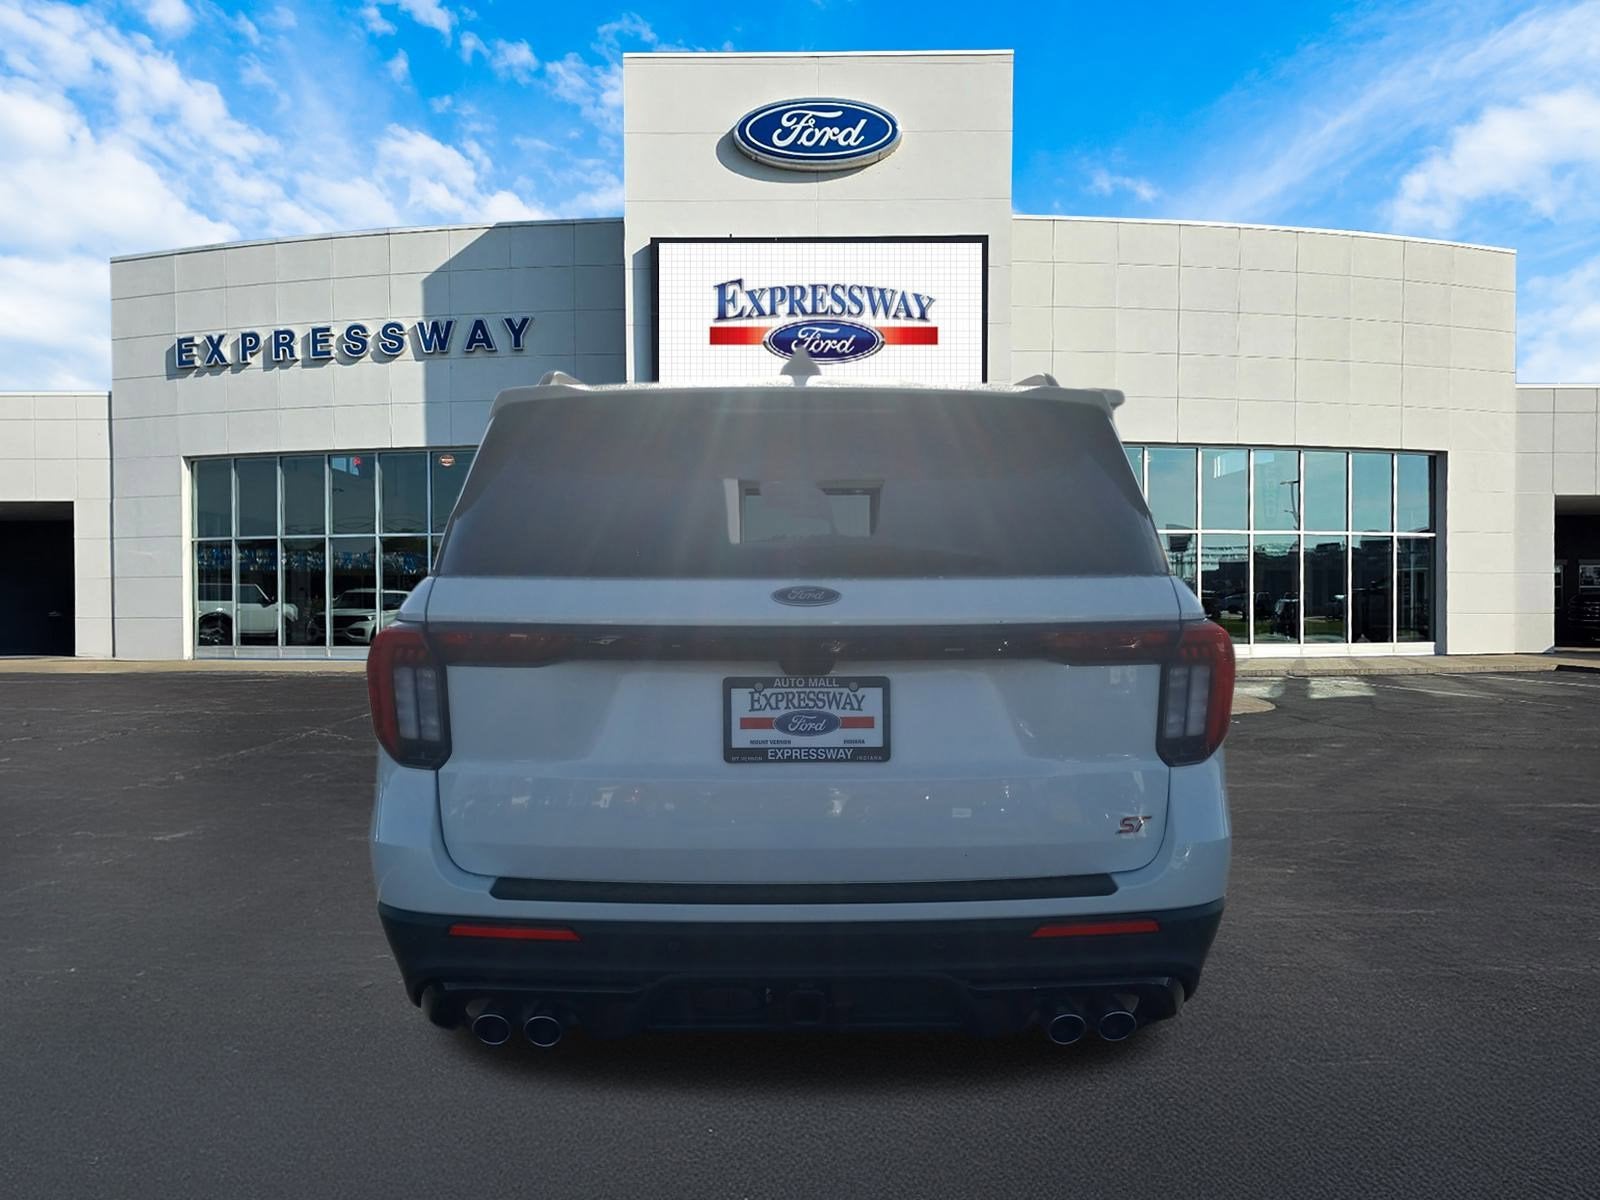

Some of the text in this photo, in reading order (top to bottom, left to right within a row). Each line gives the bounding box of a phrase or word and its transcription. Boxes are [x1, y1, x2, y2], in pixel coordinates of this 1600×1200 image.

[772, 110, 867, 147] Ford
[175, 316, 531, 368] EXPRESSWAY
[791, 327, 856, 354] Ford
[787, 588, 825, 600] Ford
[773, 678, 839, 688] AUTO MALL
[787, 715, 826, 732] Ford
[767, 748, 854, 760] EXPRESSWAY
[1115, 815, 1153, 834] ST
